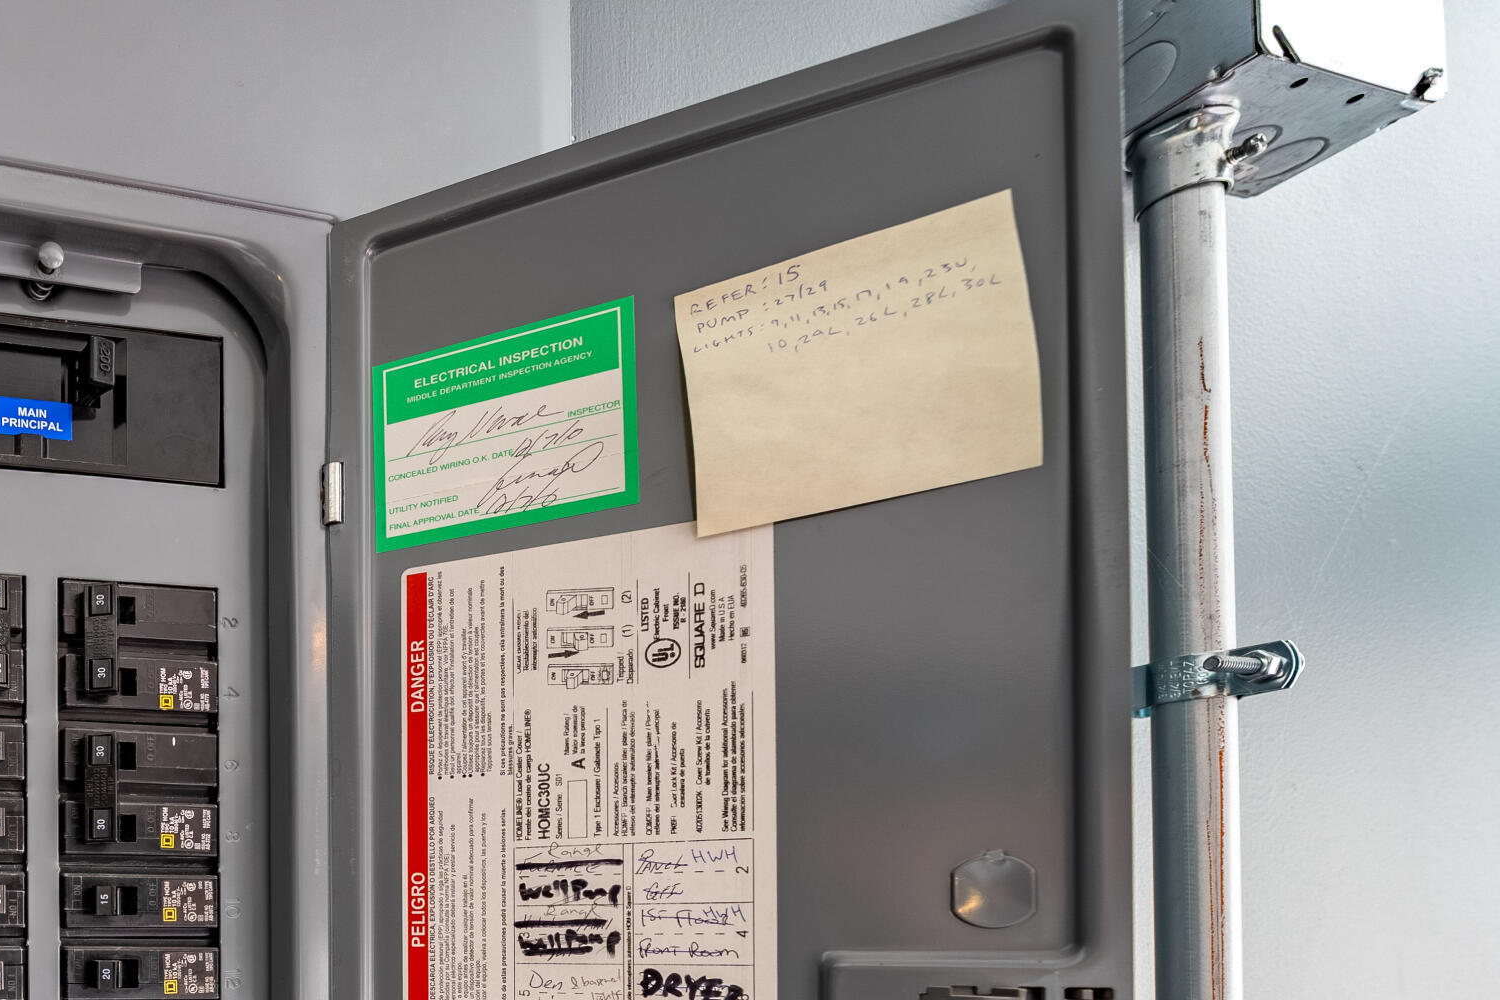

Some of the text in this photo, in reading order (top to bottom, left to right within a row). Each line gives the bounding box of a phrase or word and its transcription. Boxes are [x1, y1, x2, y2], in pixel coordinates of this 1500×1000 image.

[778, 264, 801, 285] 15
[774, 280, 828, 306] 27/29
[414, 336, 583, 388] ELECTRICAL INSPECTION
[406, 350, 593, 404] MIDDLE DEPARTMENT INSPECTION AGENCY
[18, 407, 47, 418] MAIN
[567, 400, 621, 418] INSPECTOR
[2, 417, 64, 432] PRINCIPAL
[388, 449, 513, 482] CONCEALED WIRING O.K. DATE
[388, 495, 458, 514] UTILITY NOTIFIED
[388, 507, 480, 530] FINAL APPROVAL DATE
[96, 594, 104, 606] 30
[641, 598, 649, 632] LISTED
[694, 582, 706, 668] SQUARE D
[98, 667, 106, 678] 30
[410, 639, 425, 713] DANGER
[96, 746, 104, 756] 30
[571, 758, 586, 770] A
[538, 763, 550, 840] HOMC30UC
[97, 818, 105, 830] 30
[692, 845, 738, 864] HWH
[736, 866, 749, 874] 2
[100, 894, 108, 904] 15
[428, 884, 436, 922] EXPLOSIÓN
[410, 870, 426, 948] PELIGRO
[736, 930, 748, 938] 4
[102, 968, 110, 980] 20
[529, 970, 563, 990] Den
